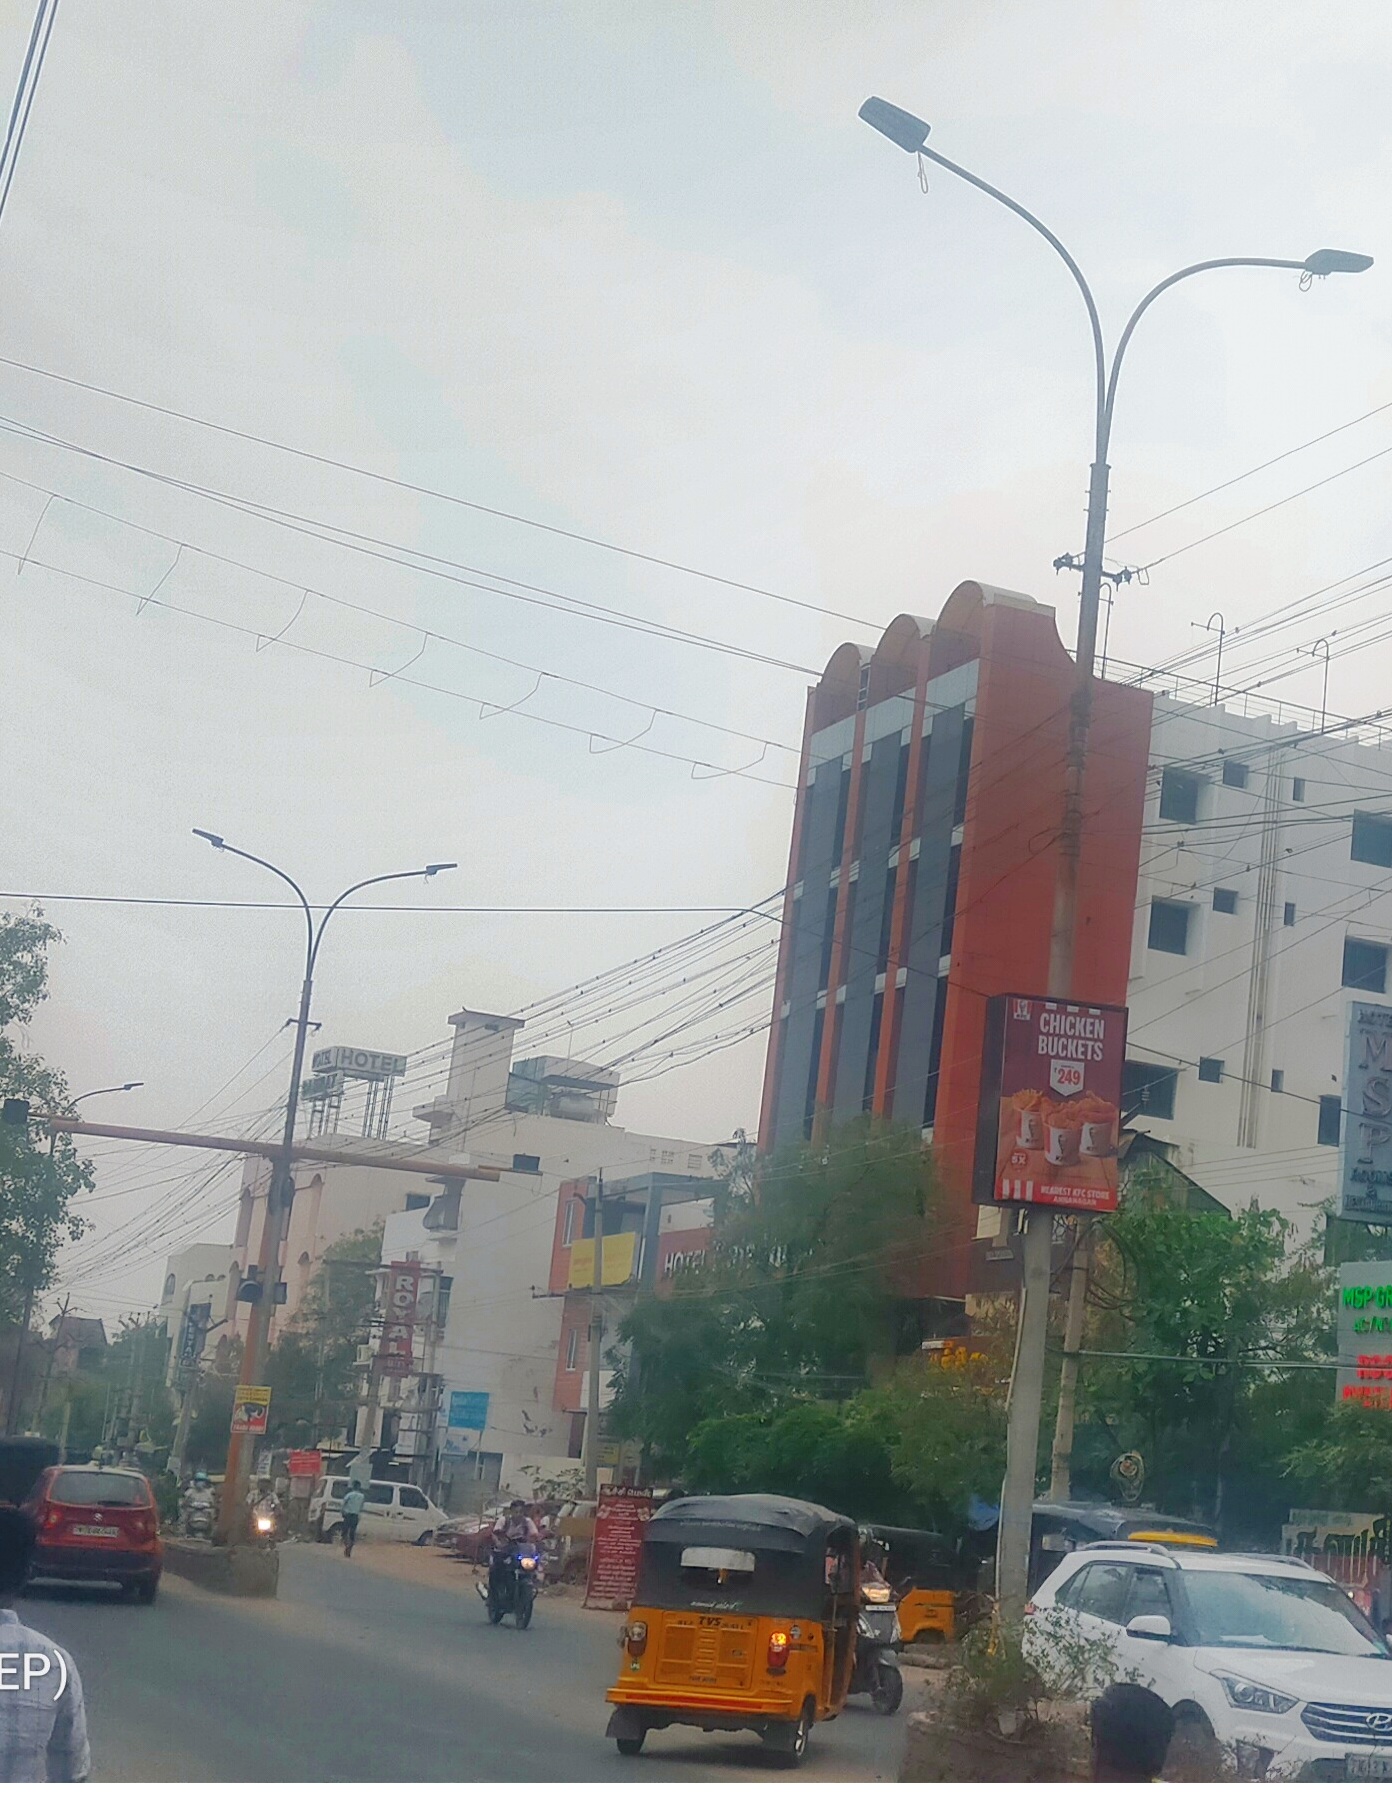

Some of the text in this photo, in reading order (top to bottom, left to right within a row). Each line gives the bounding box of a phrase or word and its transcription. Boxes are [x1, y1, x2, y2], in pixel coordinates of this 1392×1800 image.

[1039, 1012, 1105, 1040] CHICKEN
[340, 1048, 406, 1074] HOTEL
[1037, 1035, 1104, 1062] BUCKETS
[1072, 1187, 1087, 1198] KFC
[1087, 1190, 1110, 1201] STORE
[1342, 1285, 1374, 1310] MSP
[388, 1275, 415, 1355] ROYAL
[699, 1616, 722, 1626] TVS
